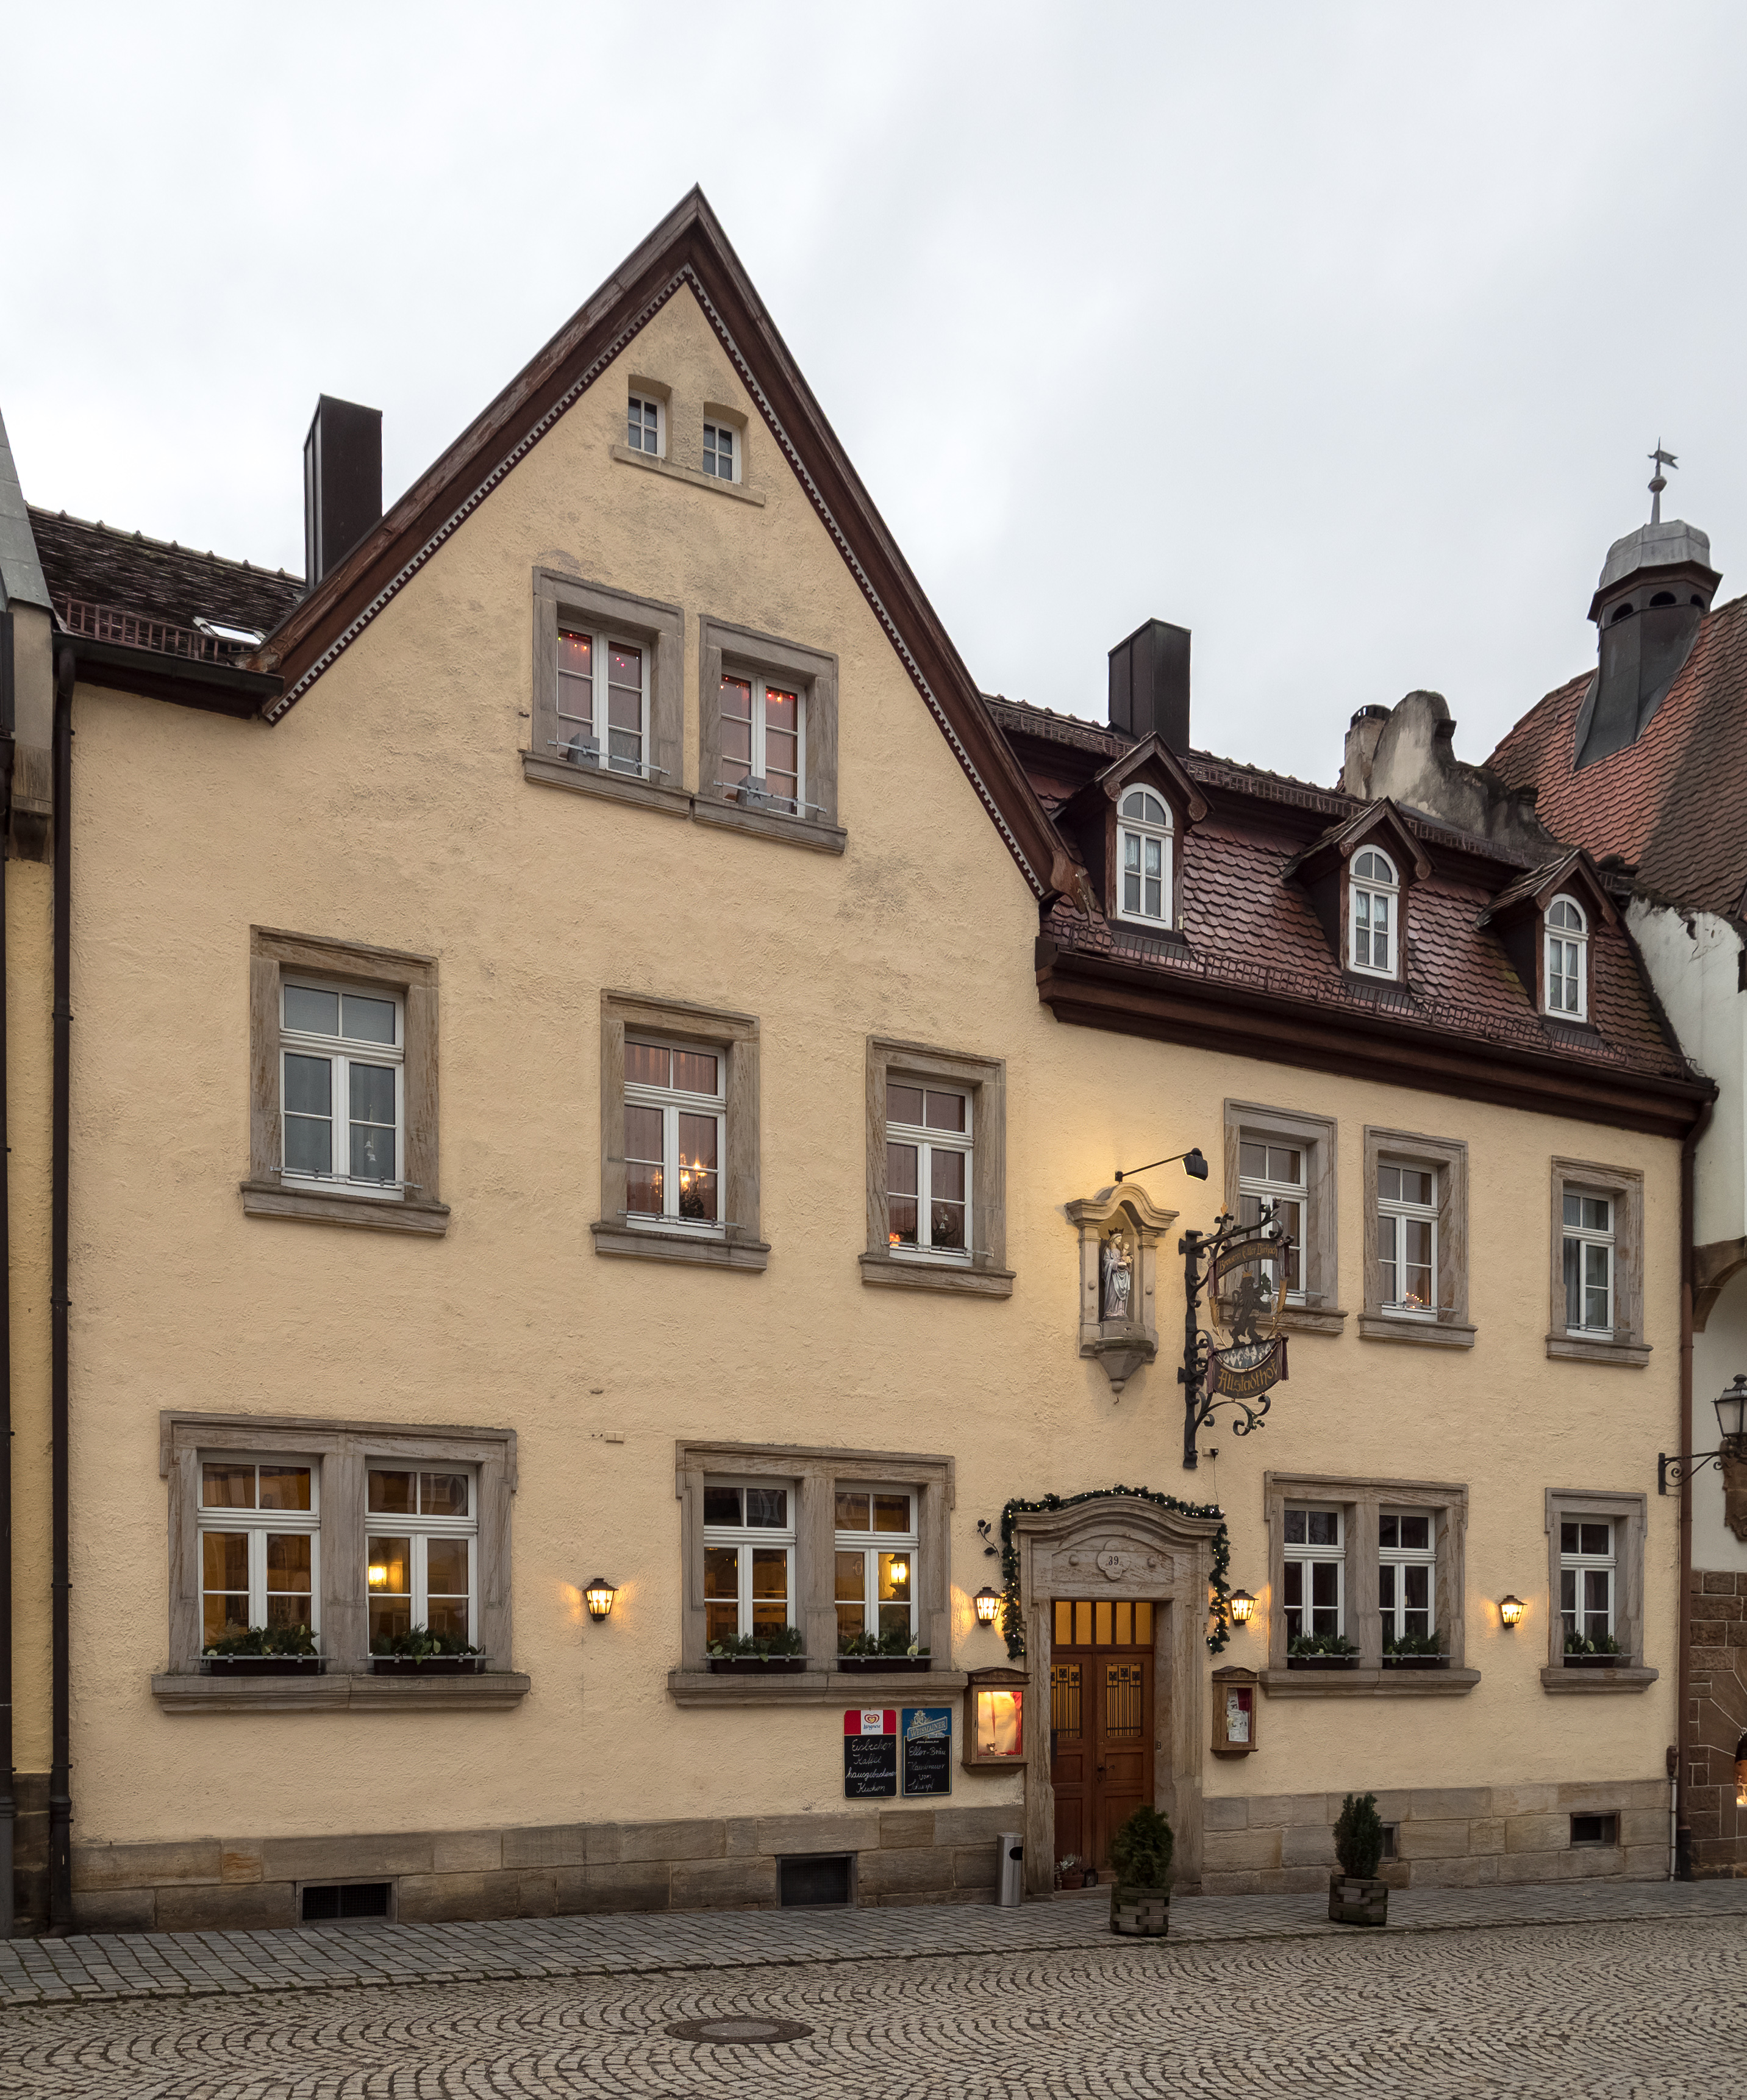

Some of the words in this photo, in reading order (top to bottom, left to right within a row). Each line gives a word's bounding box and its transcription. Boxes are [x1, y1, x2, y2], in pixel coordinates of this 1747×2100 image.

[1220, 1249, 1241, 1272] Brauerei
[1109, 1555, 1119, 1566] 39
[910, 1721, 946, 1738] WEISMAINER
[856, 1782, 885, 1794] Kuchen
